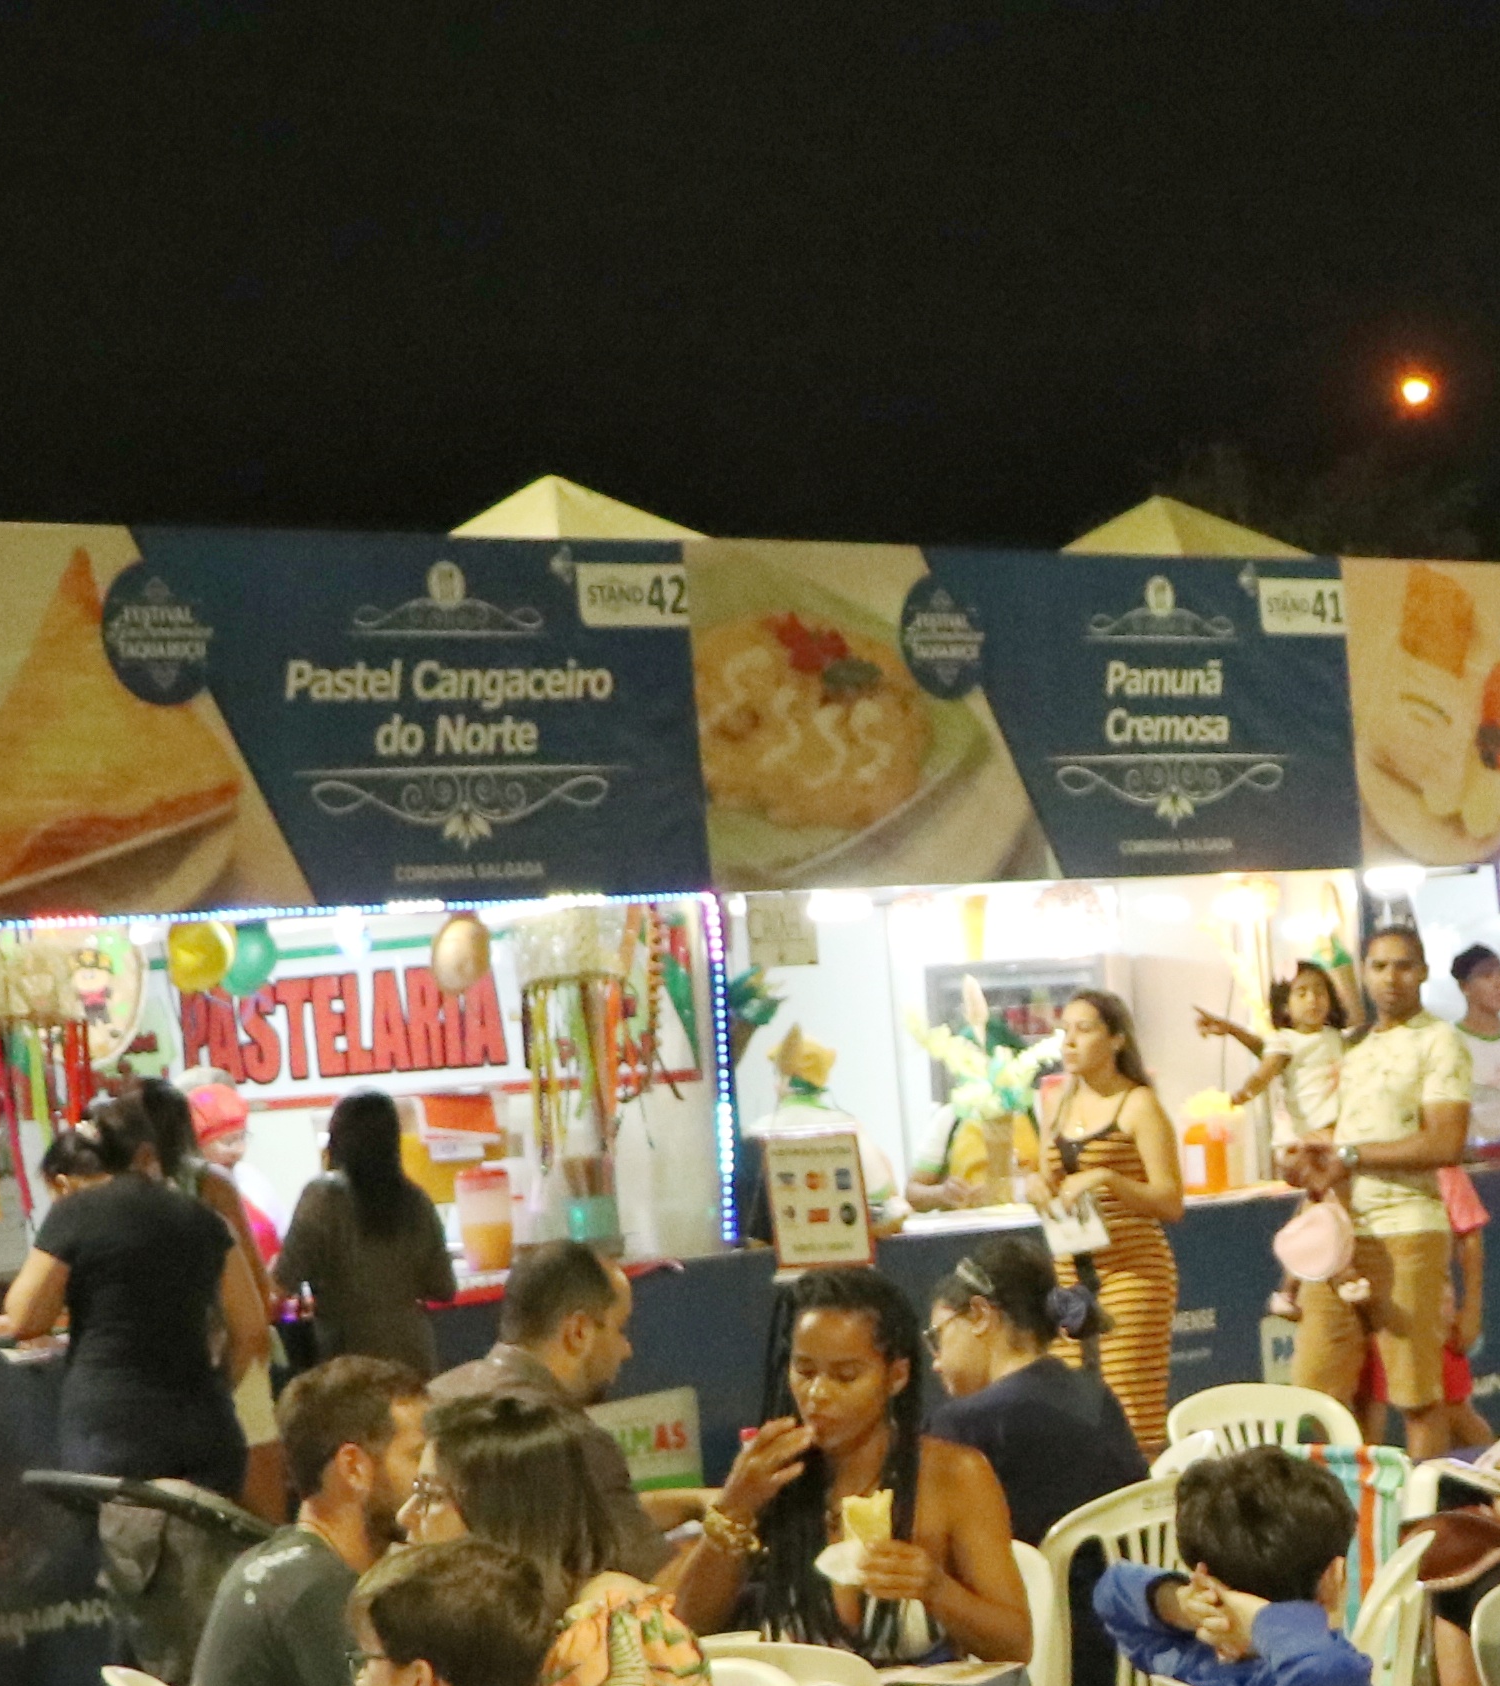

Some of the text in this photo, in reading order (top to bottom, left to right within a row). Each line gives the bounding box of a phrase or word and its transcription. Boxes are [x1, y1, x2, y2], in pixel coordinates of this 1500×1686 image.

[587, 574, 688, 616] STAND 42
[1311, 590, 1343, 624] 41
[284, 657, 614, 710] Pastel Cangaceiro
[1104, 658, 1223, 699] Pamunã
[374, 713, 539, 758] do Norte
[1105, 707, 1230, 746] Cremosa
[180, 966, 509, 1085] PASTELARIA
